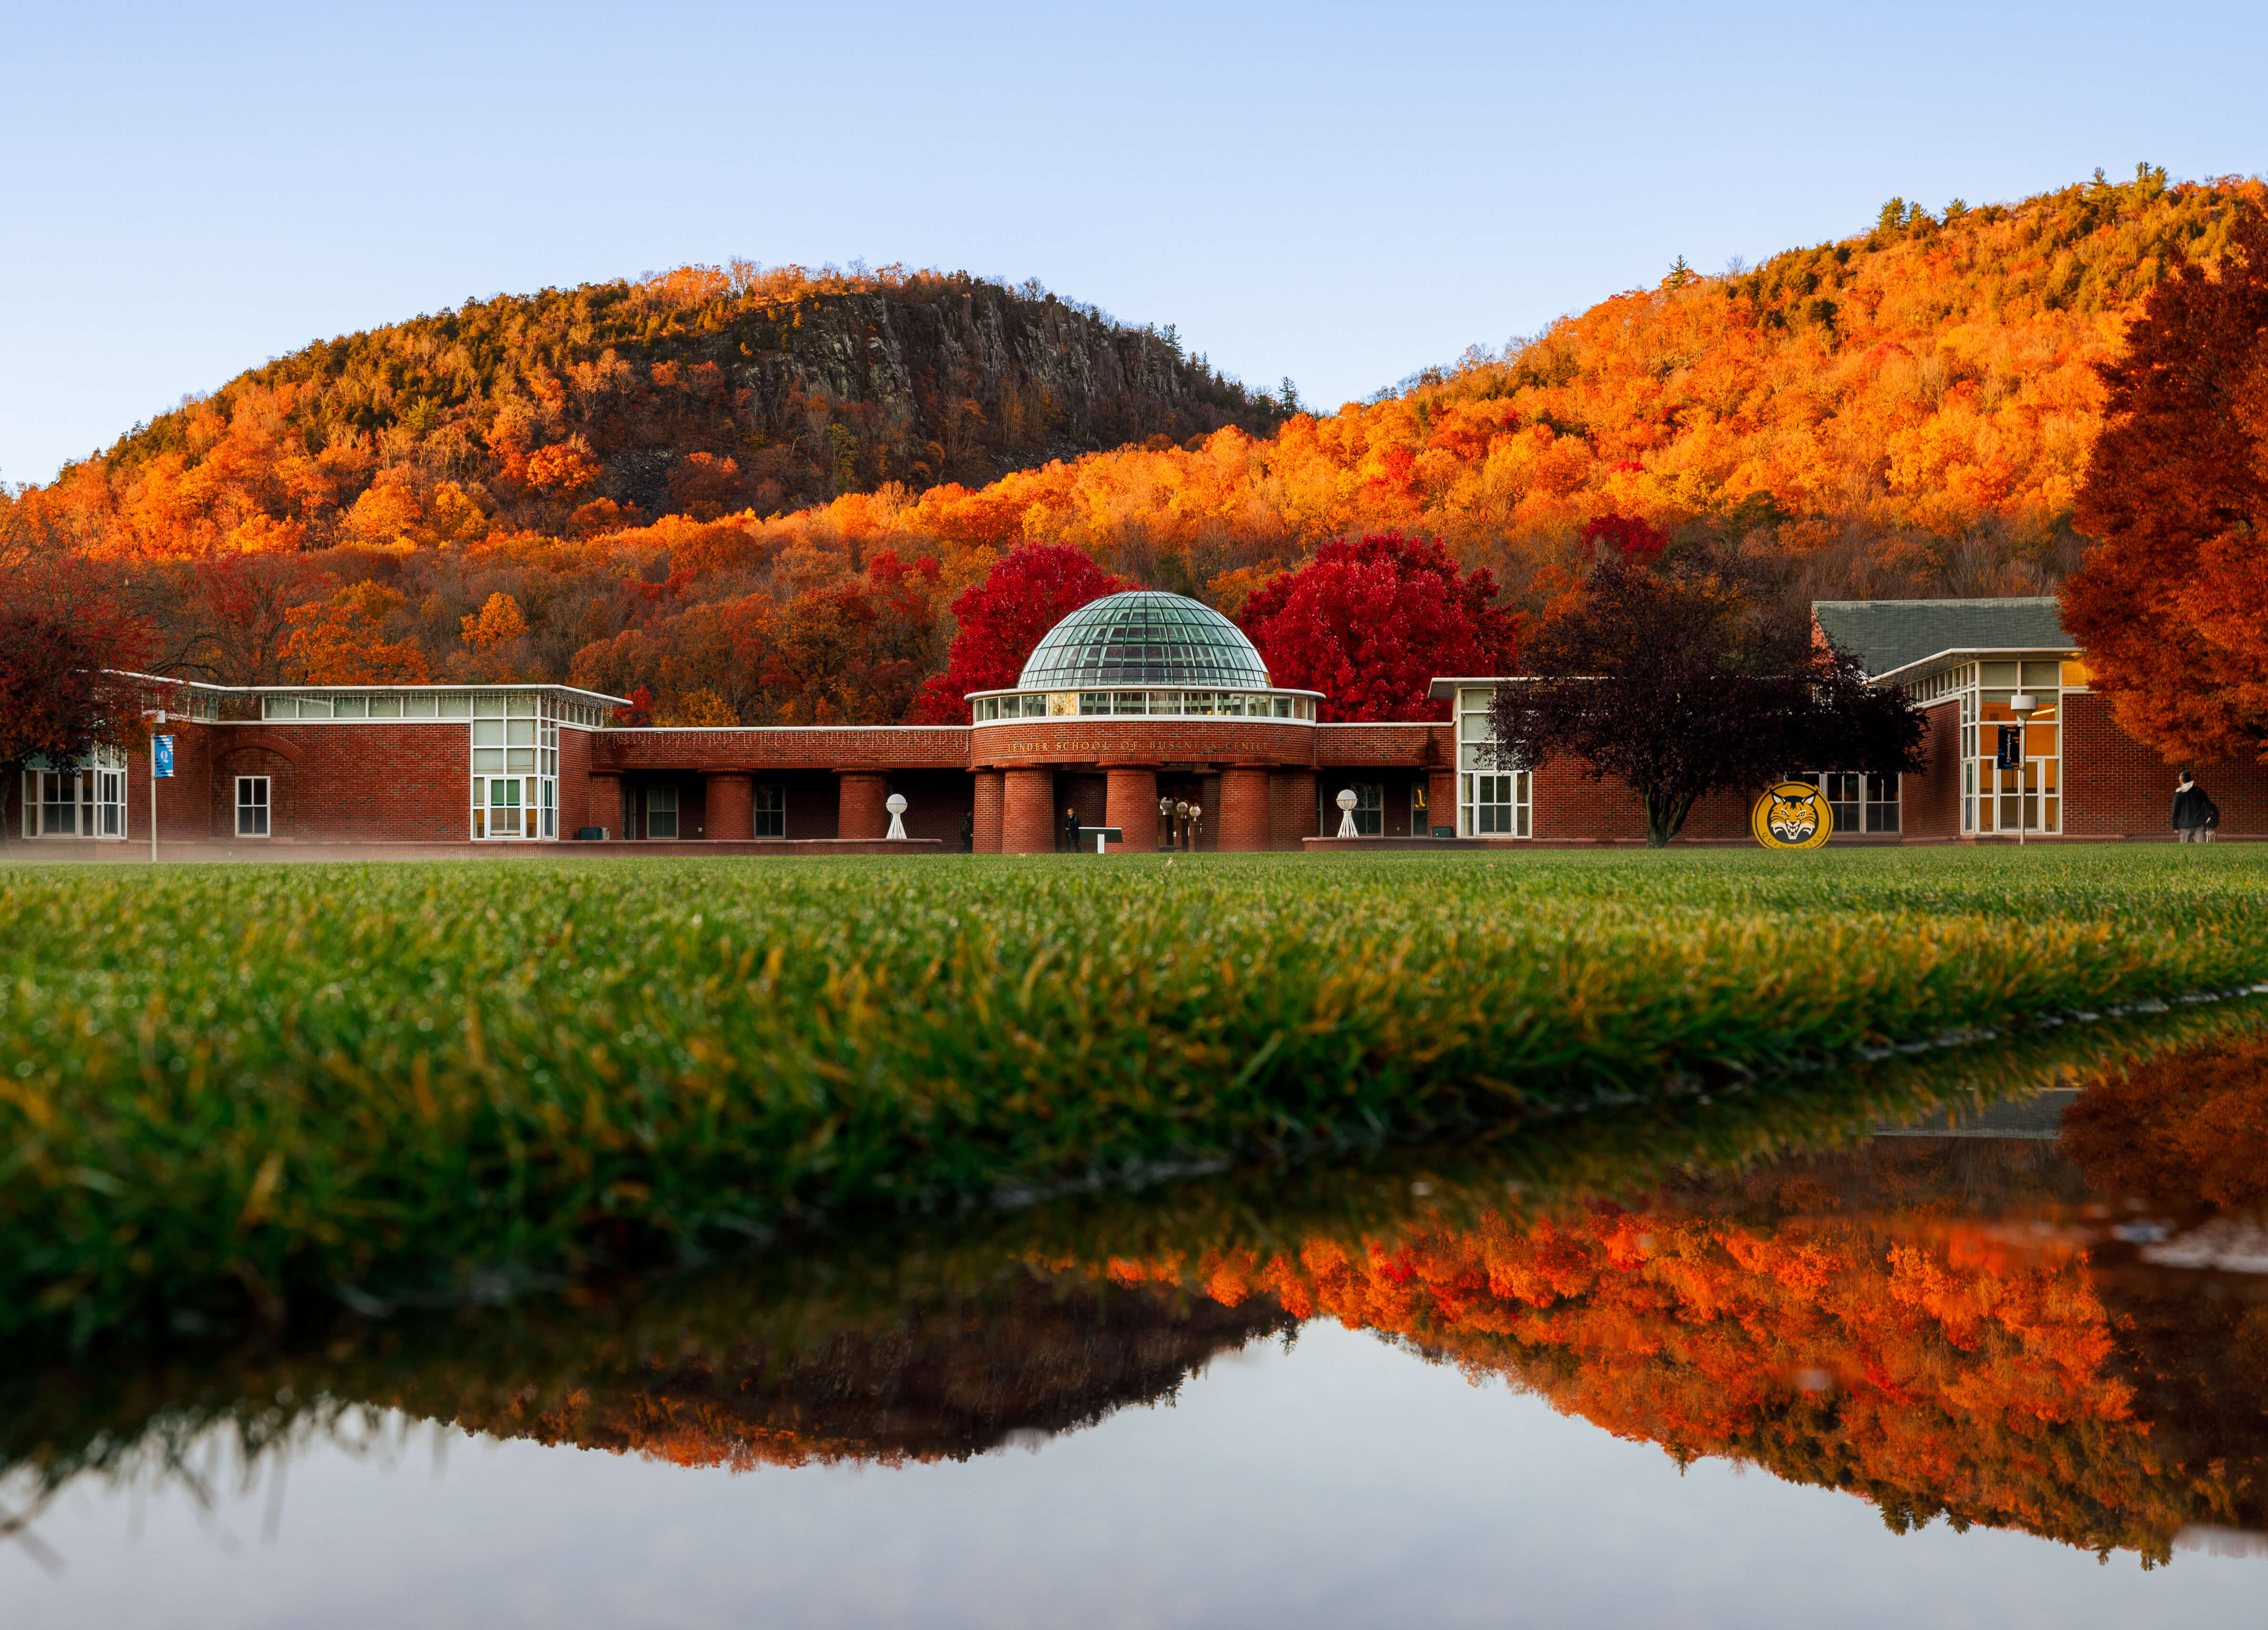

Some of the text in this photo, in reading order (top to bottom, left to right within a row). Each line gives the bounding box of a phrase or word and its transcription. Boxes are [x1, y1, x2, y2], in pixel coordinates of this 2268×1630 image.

[1008, 743, 1048, 752] LENDER
[1056, 742, 1110, 751] SCHOOL
[1150, 741, 1216, 750] BUSINESS
[1225, 742, 1269, 751] CENTER
[160, 750, 169, 763] Q
